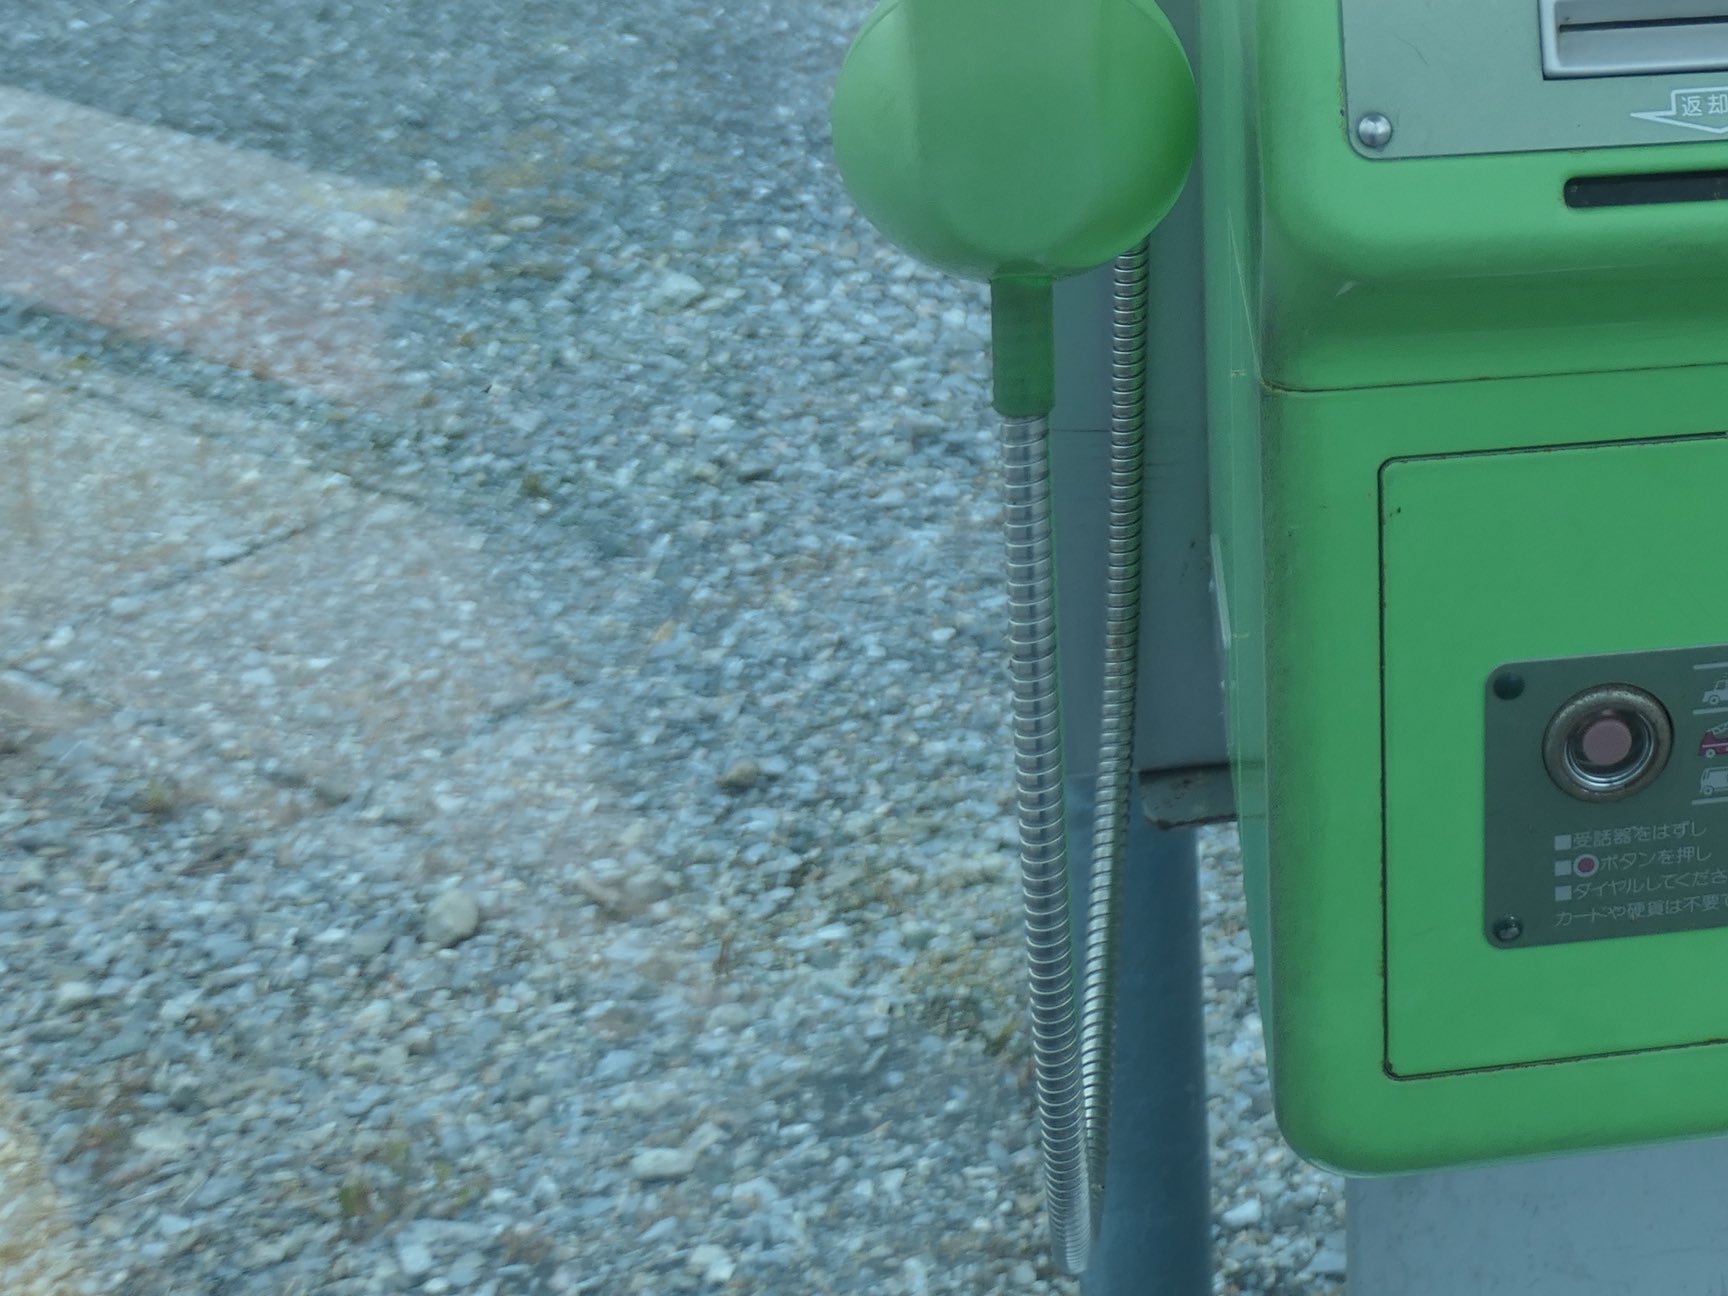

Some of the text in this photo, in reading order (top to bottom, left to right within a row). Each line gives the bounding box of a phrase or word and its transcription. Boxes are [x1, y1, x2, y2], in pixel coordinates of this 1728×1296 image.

[1572, 820, 1708, 849] 受話器をはずし
[1600, 845, 1713, 873] ボタンを押し
